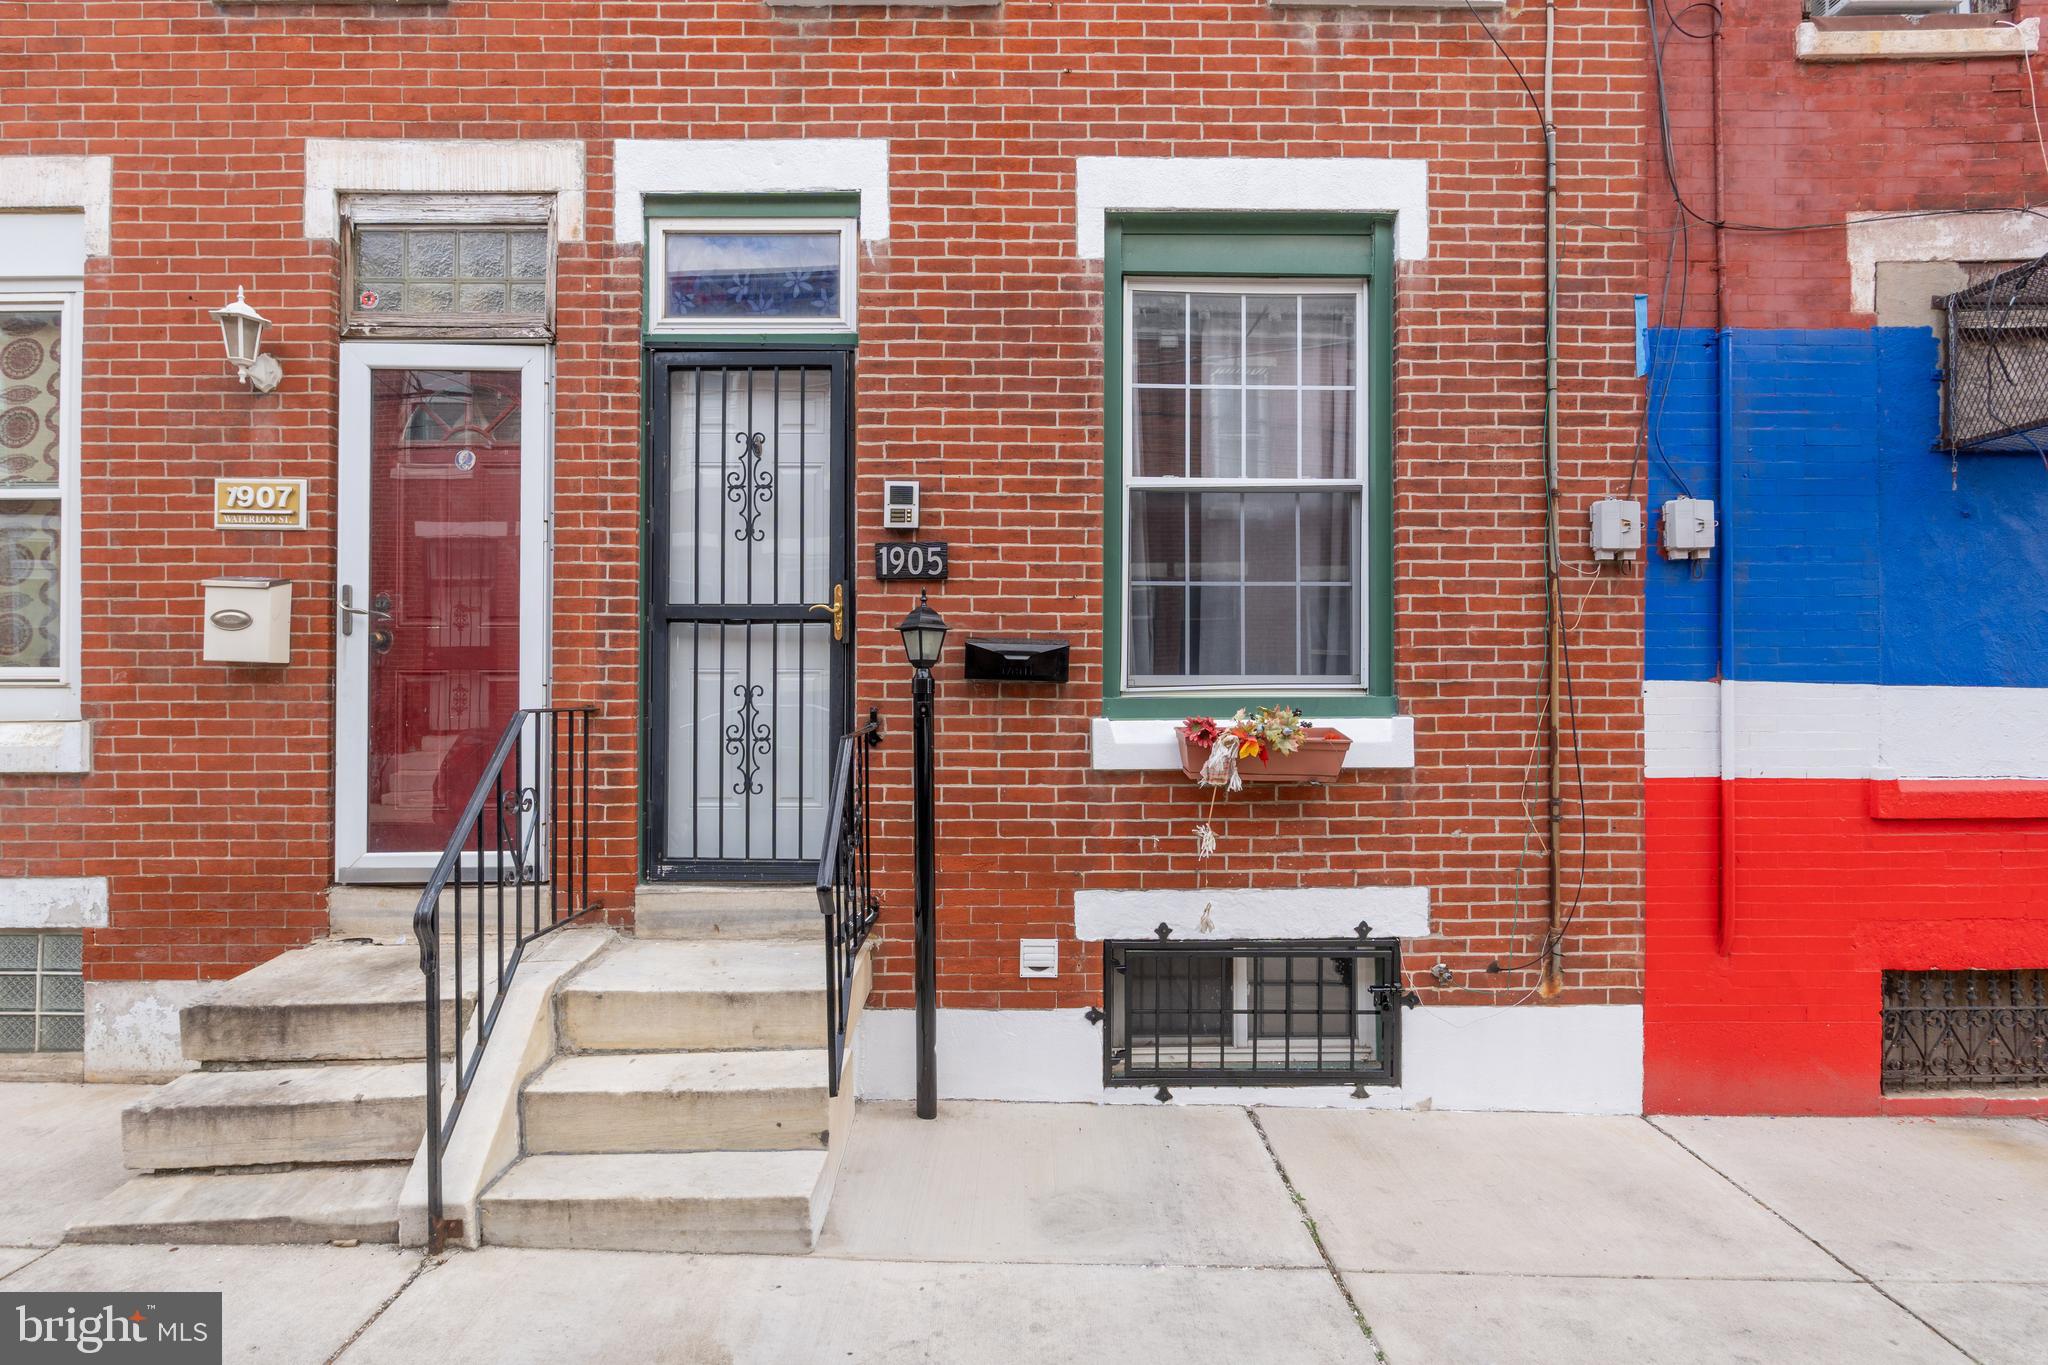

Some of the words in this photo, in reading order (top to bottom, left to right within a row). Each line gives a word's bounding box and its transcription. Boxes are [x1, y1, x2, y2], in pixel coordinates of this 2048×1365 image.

[227, 486, 293, 508] 1907
[223, 515, 275, 524] WATERLOO
[278, 515, 292, 524] ST.
[879, 546, 943, 575] 1905
